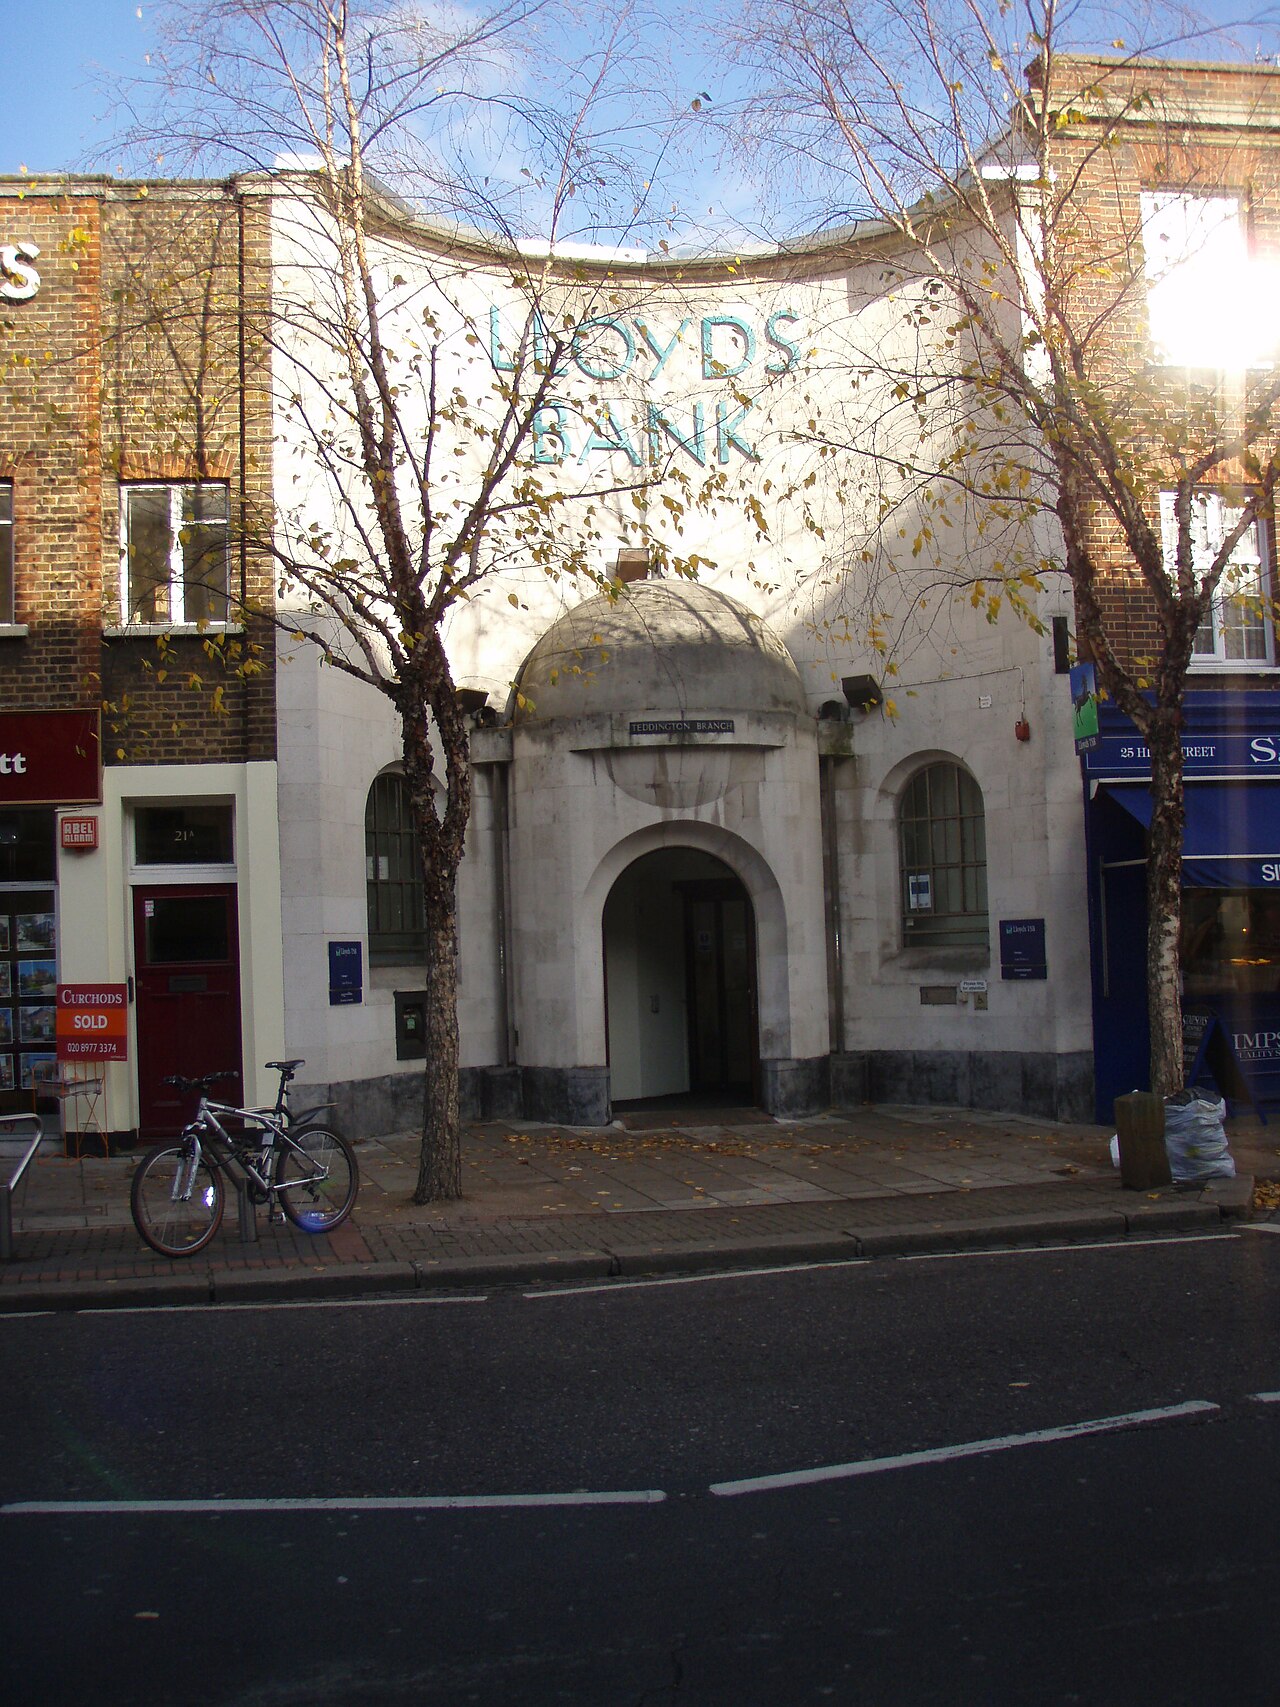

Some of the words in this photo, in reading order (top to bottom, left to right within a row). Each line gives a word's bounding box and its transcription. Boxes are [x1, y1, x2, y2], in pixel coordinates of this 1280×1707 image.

[489, 304, 801, 381] LLOYDS
[532, 397, 761, 468] BANK
[632, 722, 690, 732] TEDDINGTON
[696, 721, 733, 730] BRANCH
[1120, 747, 1134, 758] 25
[1180, 746, 1216, 757] TREET
[64, 823, 93, 834] ABEL
[61, 989, 123, 1004] CURCHODS
[74, 1015, 108, 1029] SOLD
[67, 1043, 80, 1052] 020
[81, 1043, 98, 1053] 8977
[99, 1043, 117, 1053] 3374
